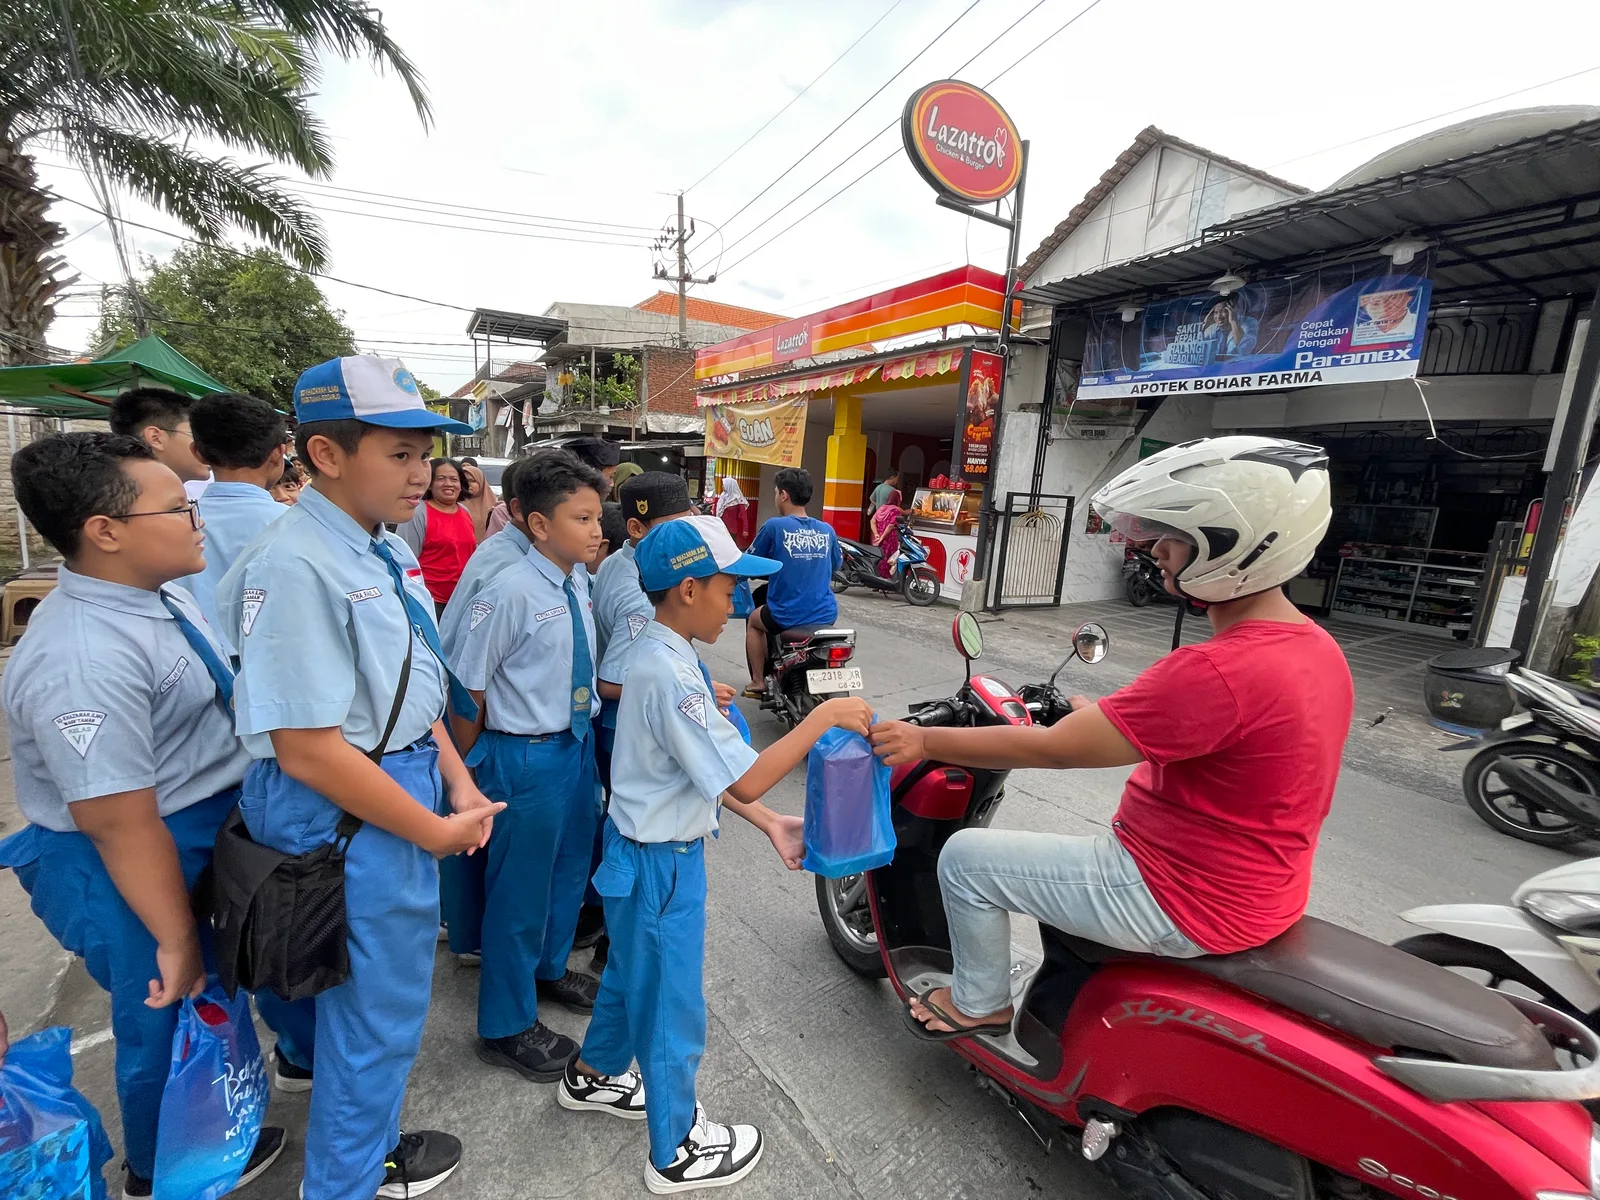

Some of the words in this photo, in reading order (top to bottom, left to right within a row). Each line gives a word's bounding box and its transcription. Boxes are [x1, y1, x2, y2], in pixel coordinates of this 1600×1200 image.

[927, 105, 996, 165] Lazatto
[935, 143, 960, 160] Chicken
[965, 155, 985, 170] Burger
[1176, 321, 1204, 335] SAKIT
[1301, 318, 1335, 331] Cepat
[1174, 332, 1204, 344] KEPALA
[1299, 326, 1349, 340] Redakan
[776, 332, 805, 352] Lazatto
[1170, 342, 1206, 354] HALANGI
[1298, 336, 1341, 349] Dengan
[1168, 353, 1204, 365] DEADLINE
[1294, 348, 1412, 370] Paramex
[1130, 380, 1189, 395] APOTEK
[1193, 376, 1252, 391] BOHAR
[1258, 370, 1323, 387] FARMA
[739, 416, 775, 442] CUAN
[966, 457, 988, 466] HANYA!
[822, 671, 843, 681] 2318
[849, 669, 860, 680] XR
[68, 726, 92, 735] KELAS
[72, 734, 87, 745] VI
[1112, 998, 1267, 1052] Stylish
